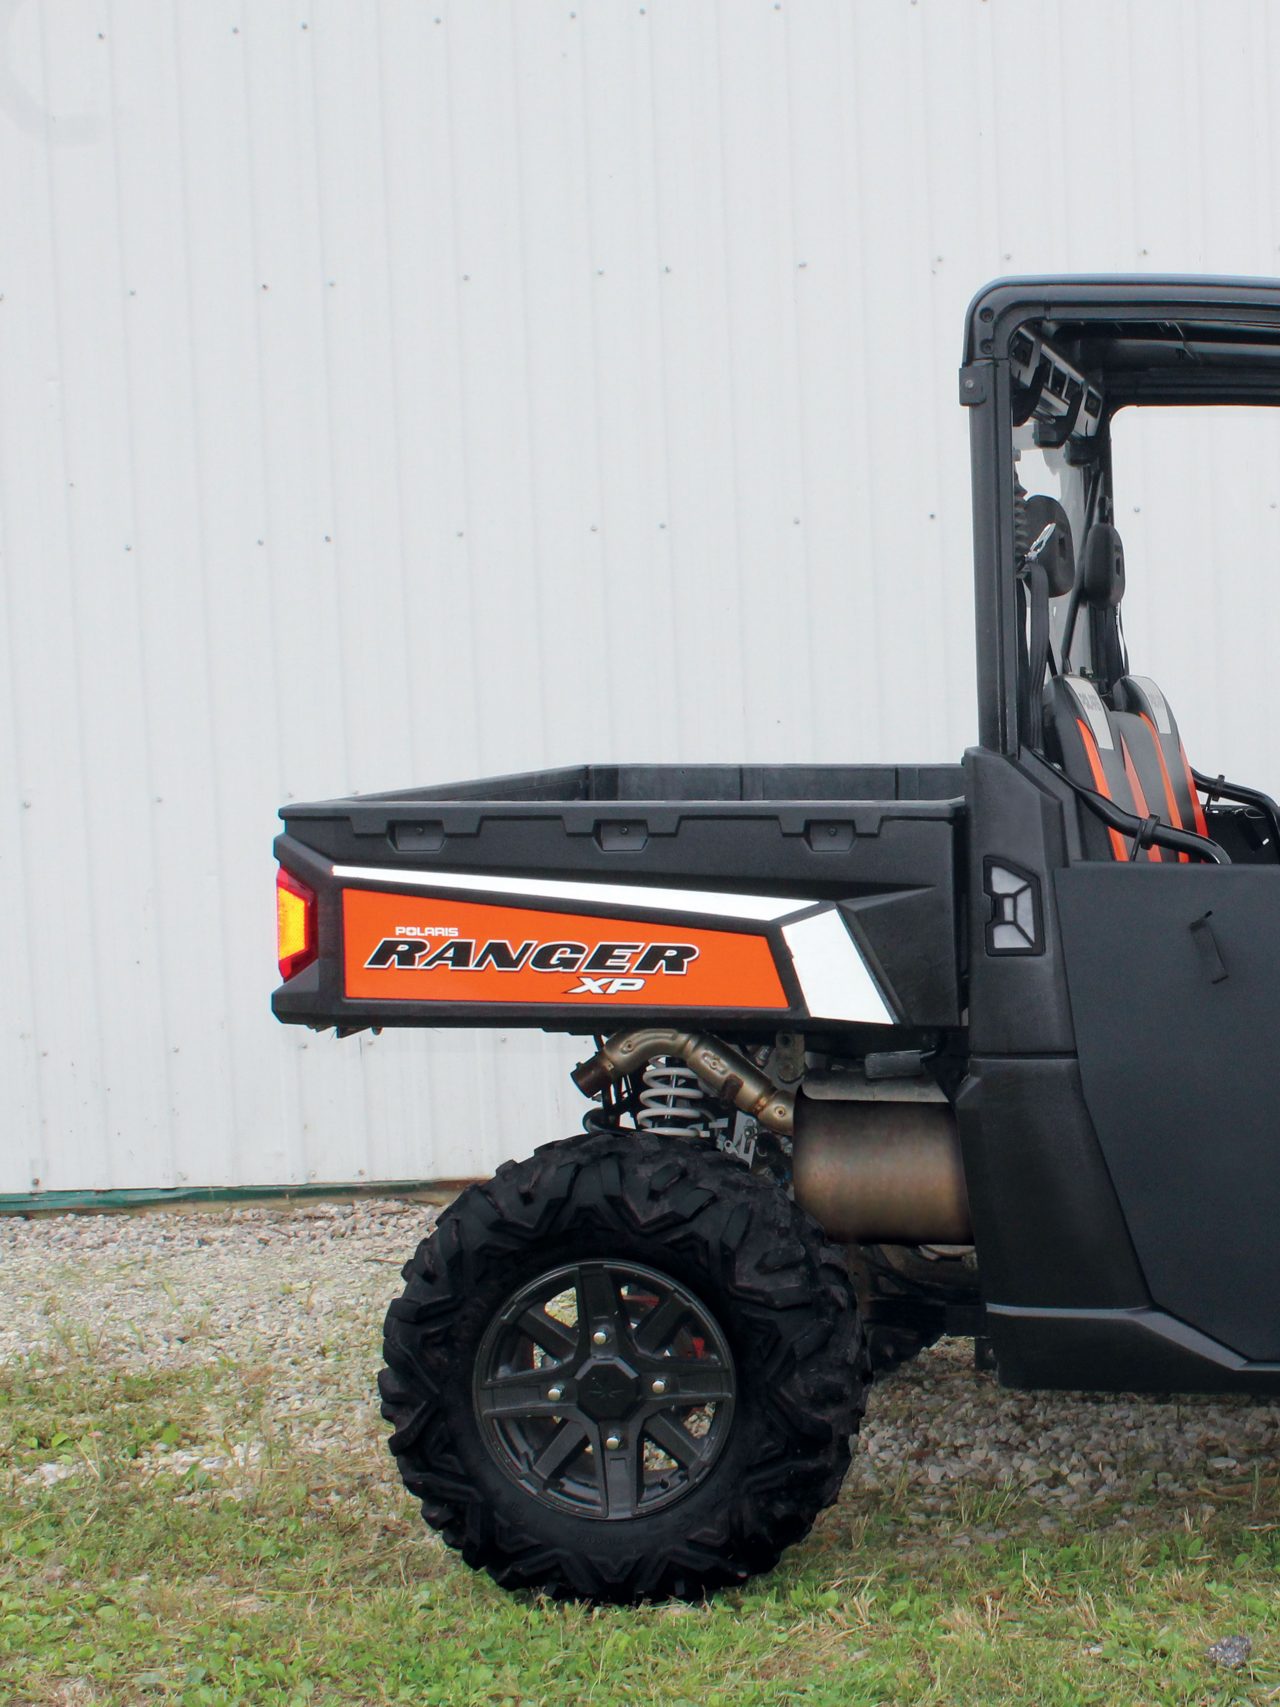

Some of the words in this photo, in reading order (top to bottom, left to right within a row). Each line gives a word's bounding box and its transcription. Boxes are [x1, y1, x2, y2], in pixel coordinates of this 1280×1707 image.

[395, 926, 459, 937] POLARIS
[364, 937, 699, 974] RANGER
[563, 976, 646, 995] XP
